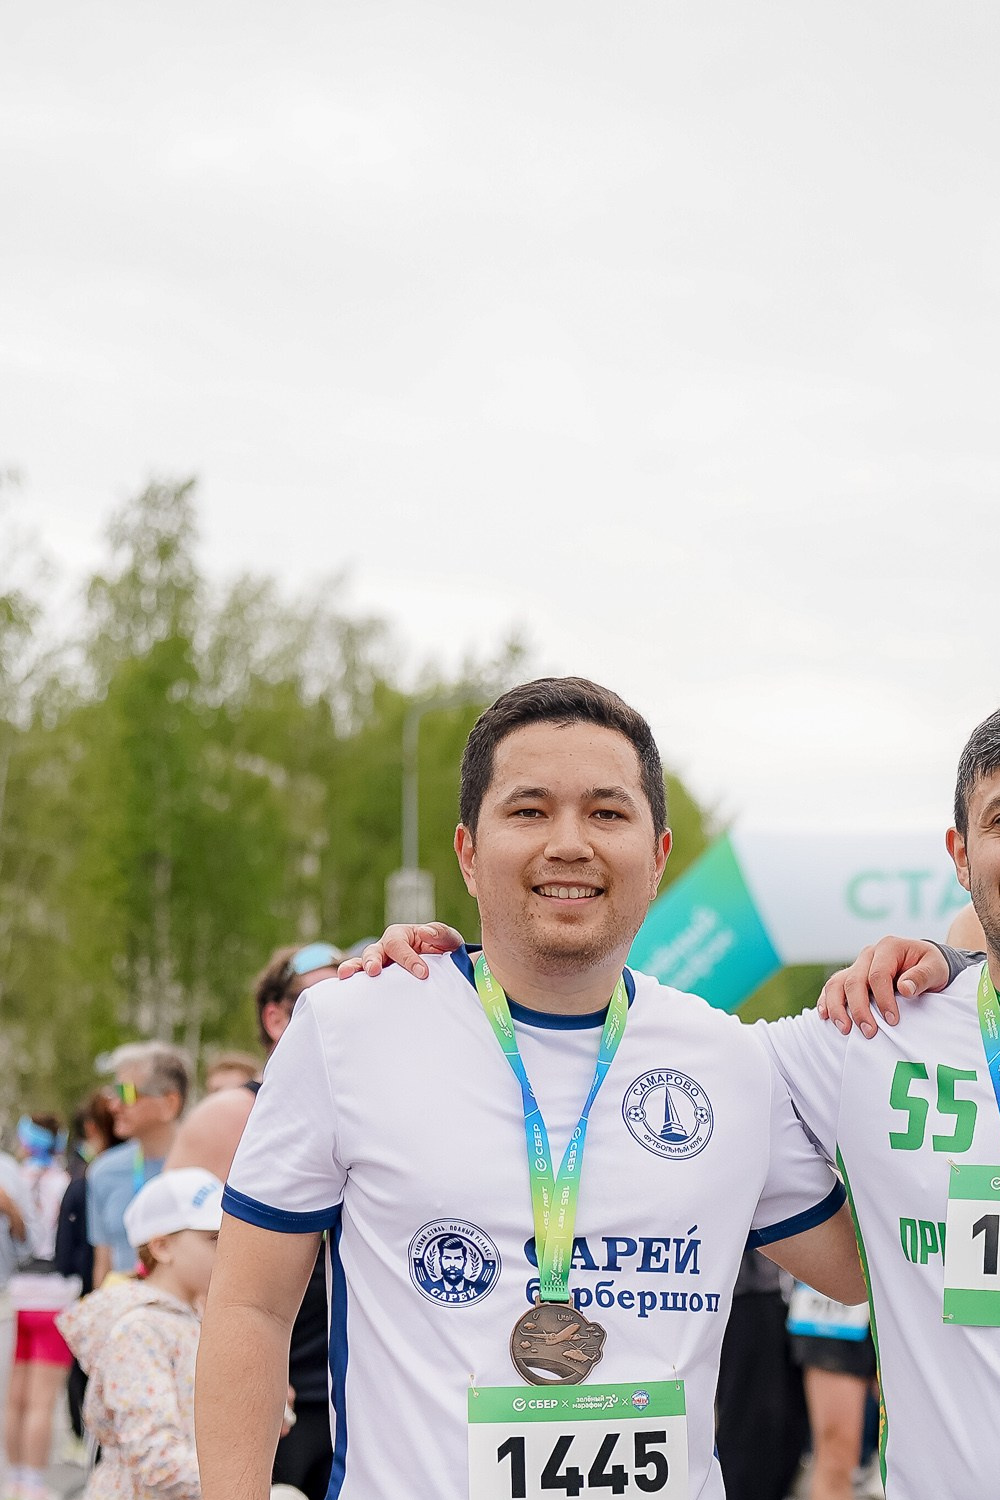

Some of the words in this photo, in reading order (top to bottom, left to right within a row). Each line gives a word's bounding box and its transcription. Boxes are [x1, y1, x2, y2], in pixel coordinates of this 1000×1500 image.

[633, 1073, 699, 1097] САМАРОВО
[888, 1060, 978, 1153] 55
[533, 1123, 544, 1155] СБЕР
[643, 1134, 690, 1153] ФУТБОЛЬНЫЙ
[690, 1135, 703, 1149] КЛУБ
[566, 1142, 578, 1172] СБЕР
[561, 1185, 570, 1205] 185
[558, 1208, 566, 1229] лет
[430, 1285, 478, 1302] САРЕЙ
[525, 1278, 721, 1318] брбершоп
[528, 1399, 558, 1409] СБЕР
[497, 1430, 669, 1499] 1445
